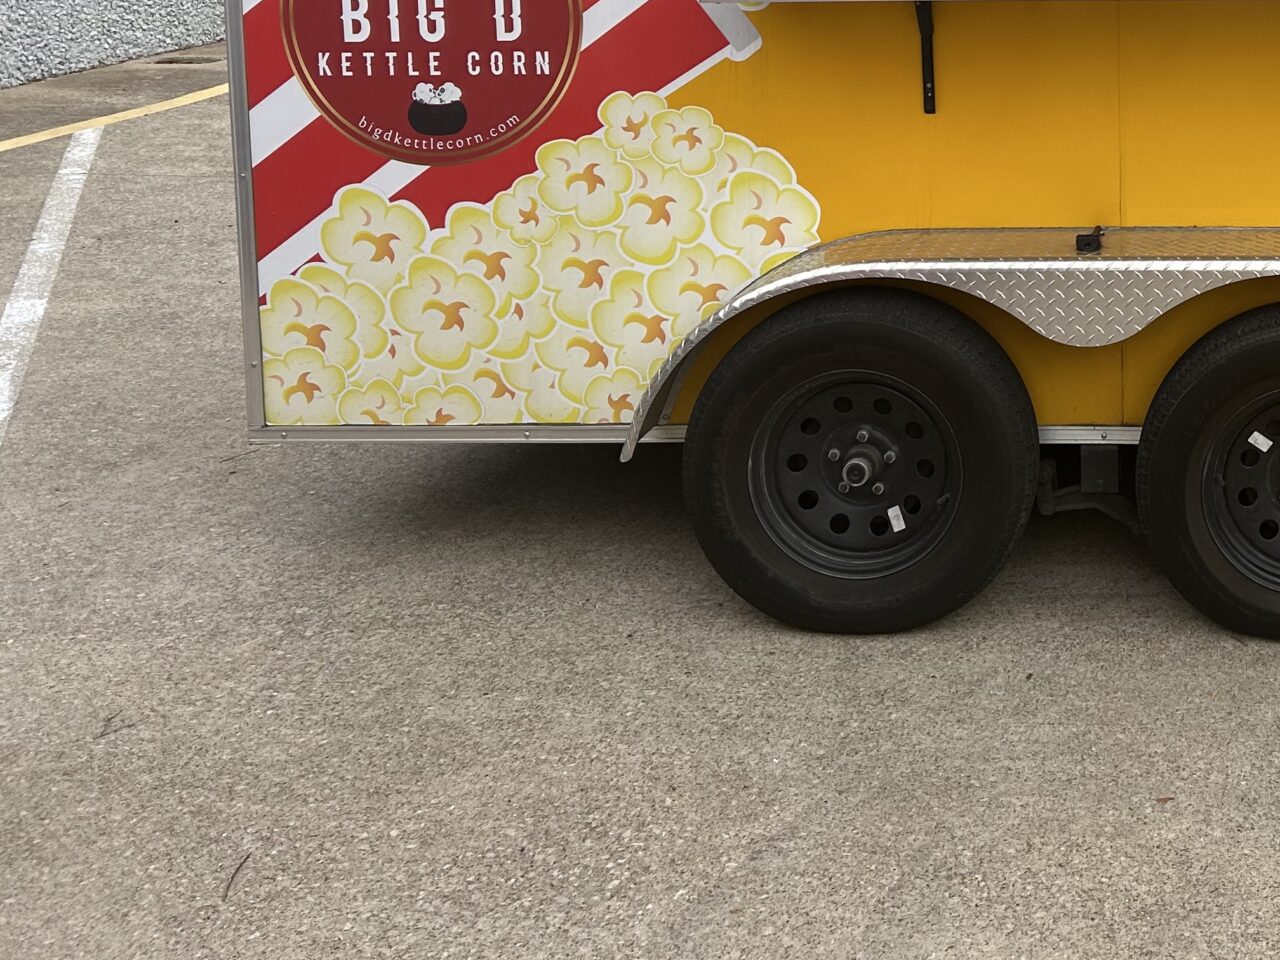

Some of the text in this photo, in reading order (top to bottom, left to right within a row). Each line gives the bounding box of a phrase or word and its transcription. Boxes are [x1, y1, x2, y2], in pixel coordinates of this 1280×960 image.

[318, 50, 550, 77] KETTLE CORN
[358, 113, 521, 151] bigdkettlecorn.com
